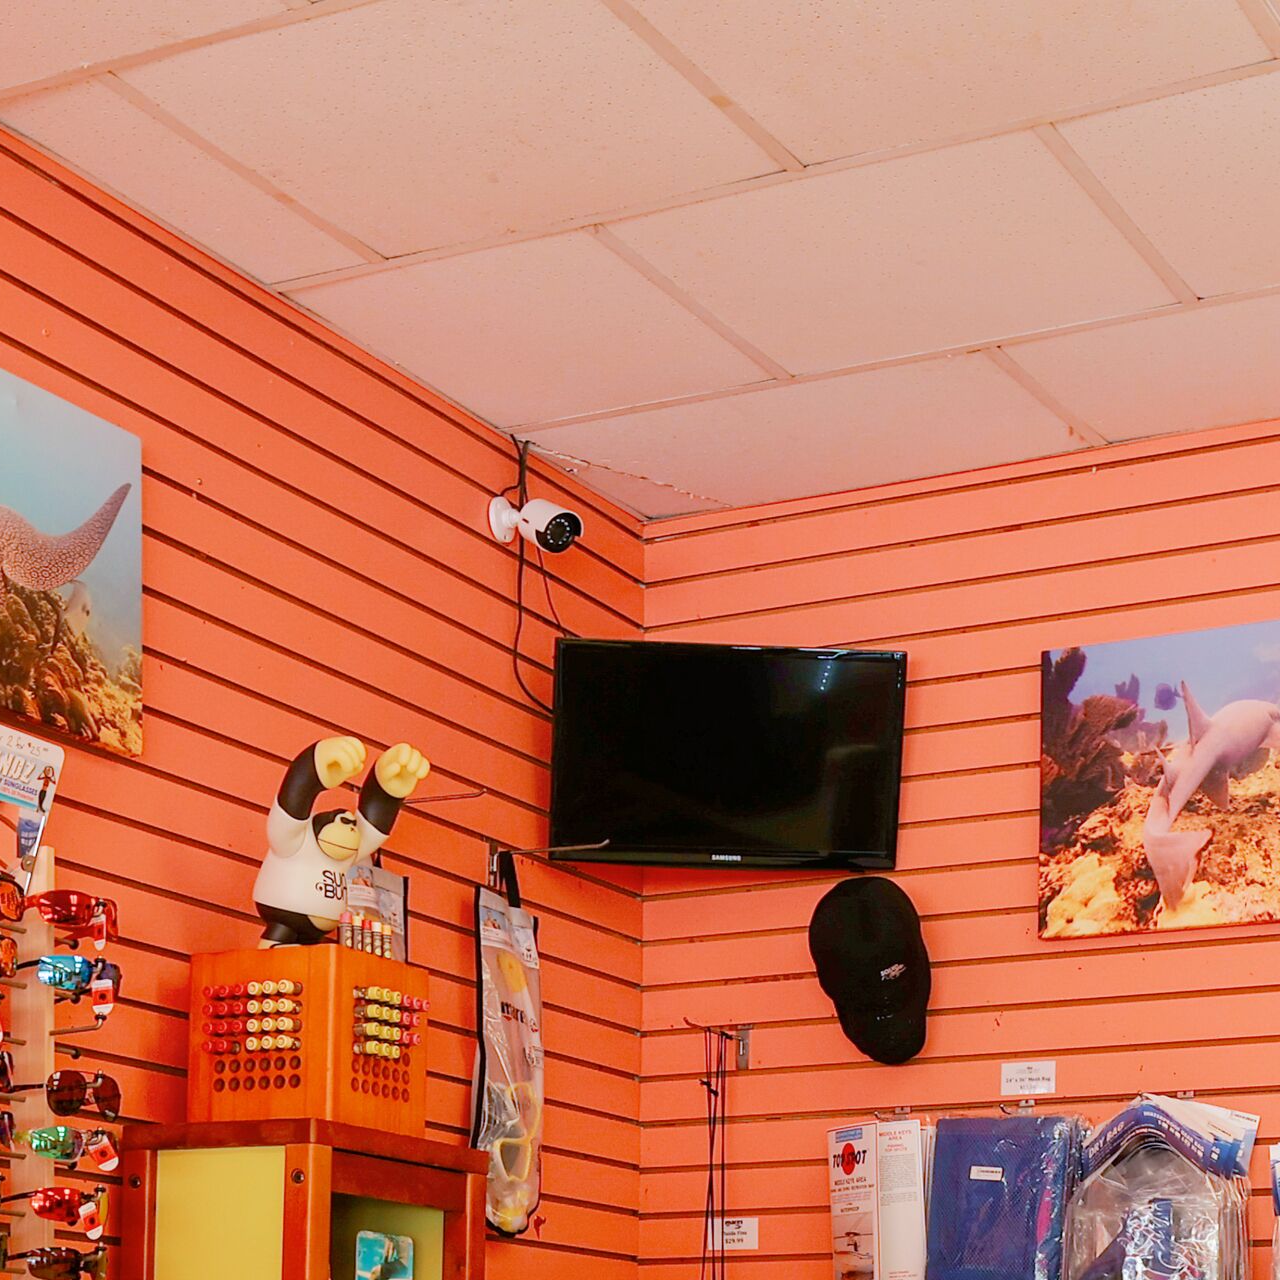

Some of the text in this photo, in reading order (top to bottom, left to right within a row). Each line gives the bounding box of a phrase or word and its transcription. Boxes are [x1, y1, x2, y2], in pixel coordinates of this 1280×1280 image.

[4, 779, 38, 796] SUNGLASSES
[711, 854, 741, 862] SAMSUNG
[1088, 1121, 1125, 1159] DRY BAG
